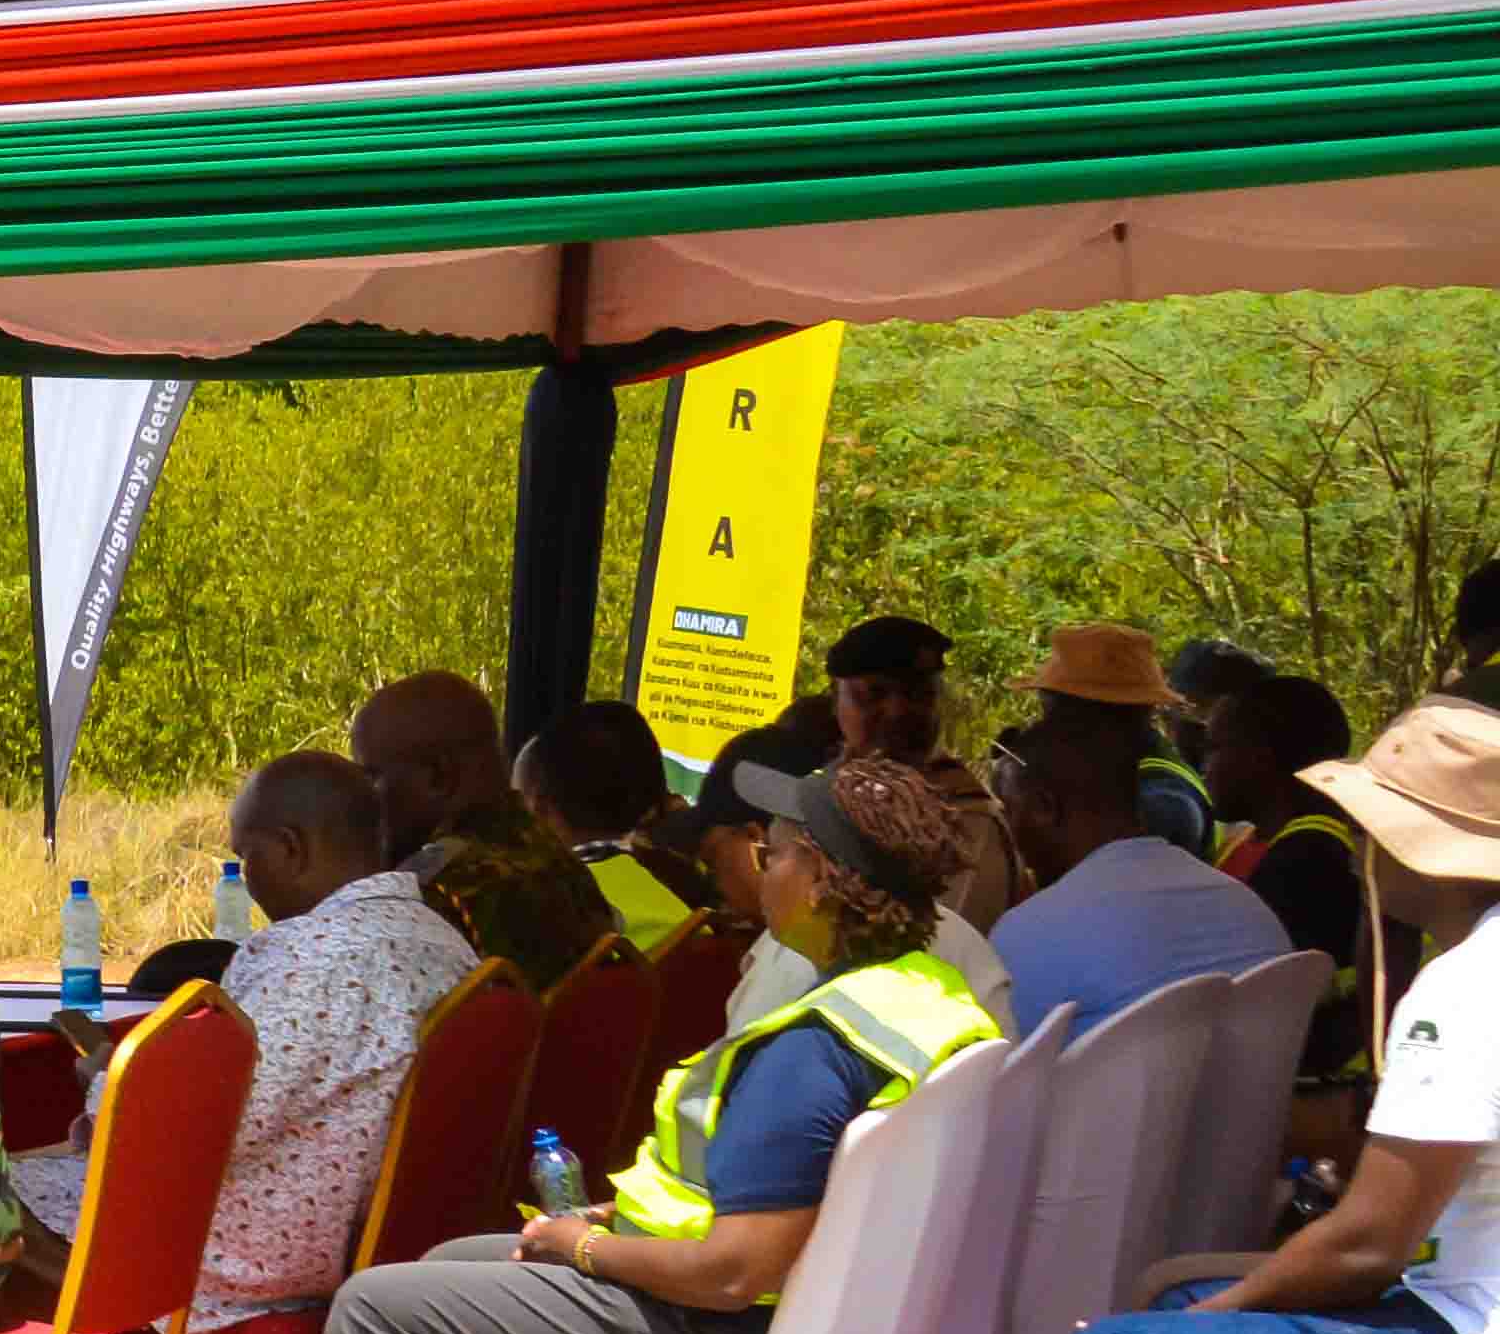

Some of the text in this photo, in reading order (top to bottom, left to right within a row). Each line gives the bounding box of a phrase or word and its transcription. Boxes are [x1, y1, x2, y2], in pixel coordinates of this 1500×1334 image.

[71, 380, 180, 669] Quality Highways, Bette
[674, 610, 740, 636] DHAMIRA
